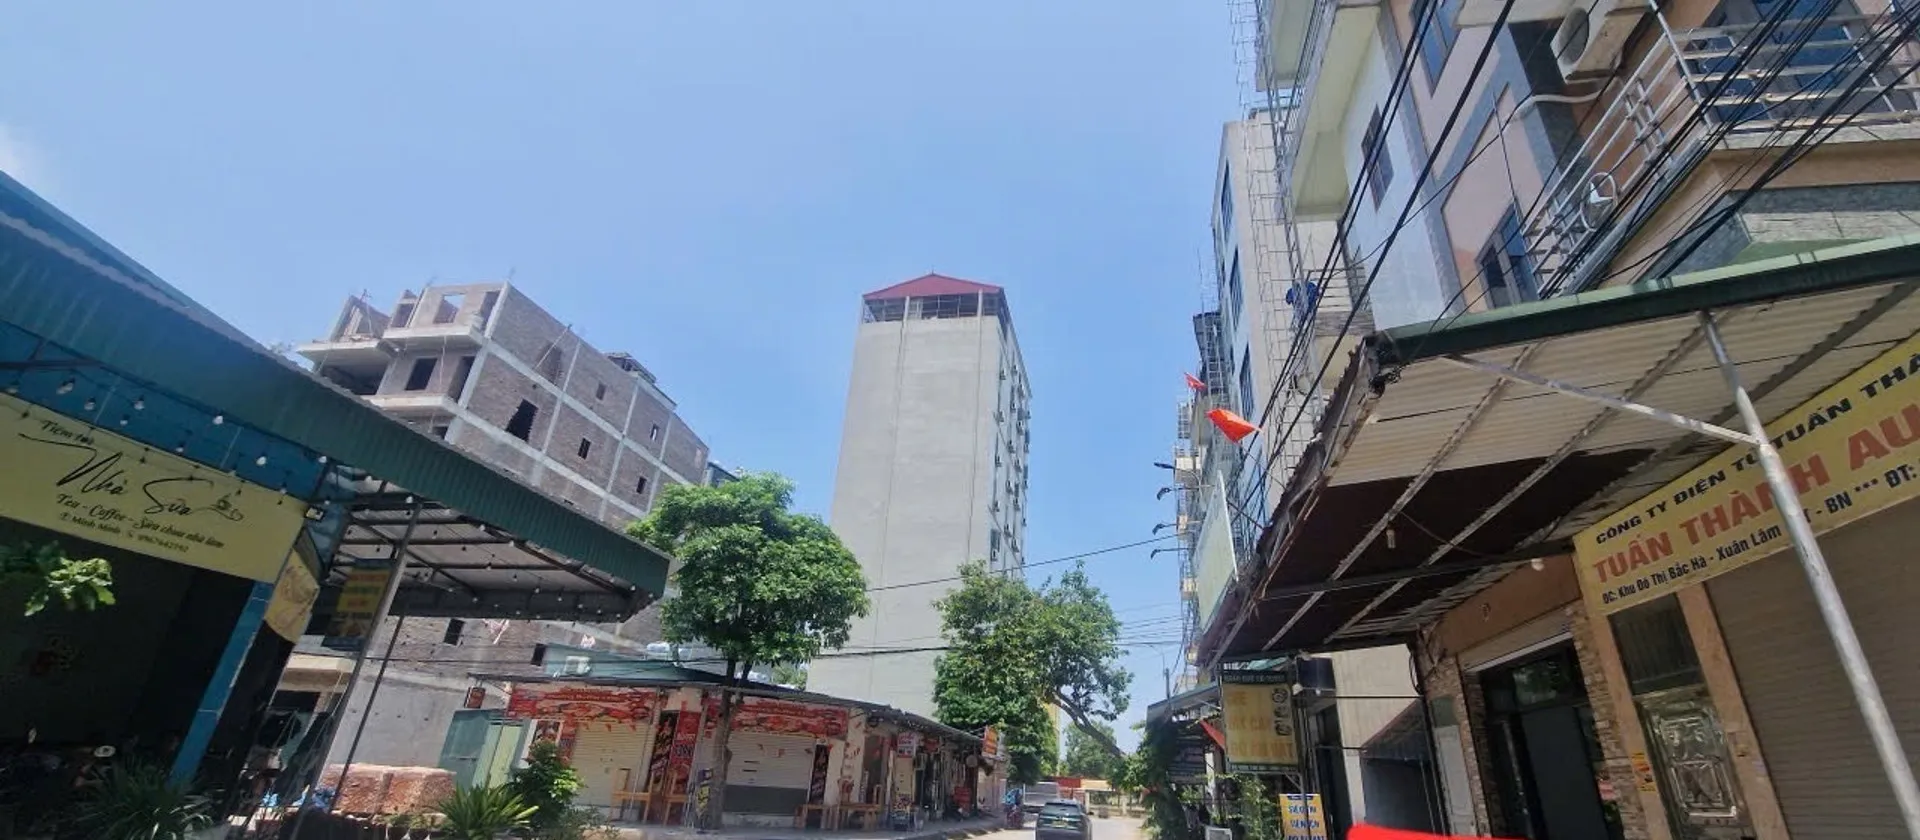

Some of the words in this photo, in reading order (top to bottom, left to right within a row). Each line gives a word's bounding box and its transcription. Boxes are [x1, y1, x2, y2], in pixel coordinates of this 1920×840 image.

[1596, 515, 1642, 545] CÔNG
[1646, 501, 1667, 519] TY
[1674, 469, 1726, 505] ĐIỆN
[1618, 584, 1636, 599] Khu
[1636, 577, 1650, 592] Đô
[1651, 570, 1668, 586] Thị
[1668, 560, 1690, 580] Bắc
[1690, 555, 1708, 573] Hà
[1715, 538, 1750, 562] Xuân
[1750, 524, 1783, 548] Lâm
[1824, 491, 1853, 514] BN
[1592, 531, 1675, 583] TUẤN
